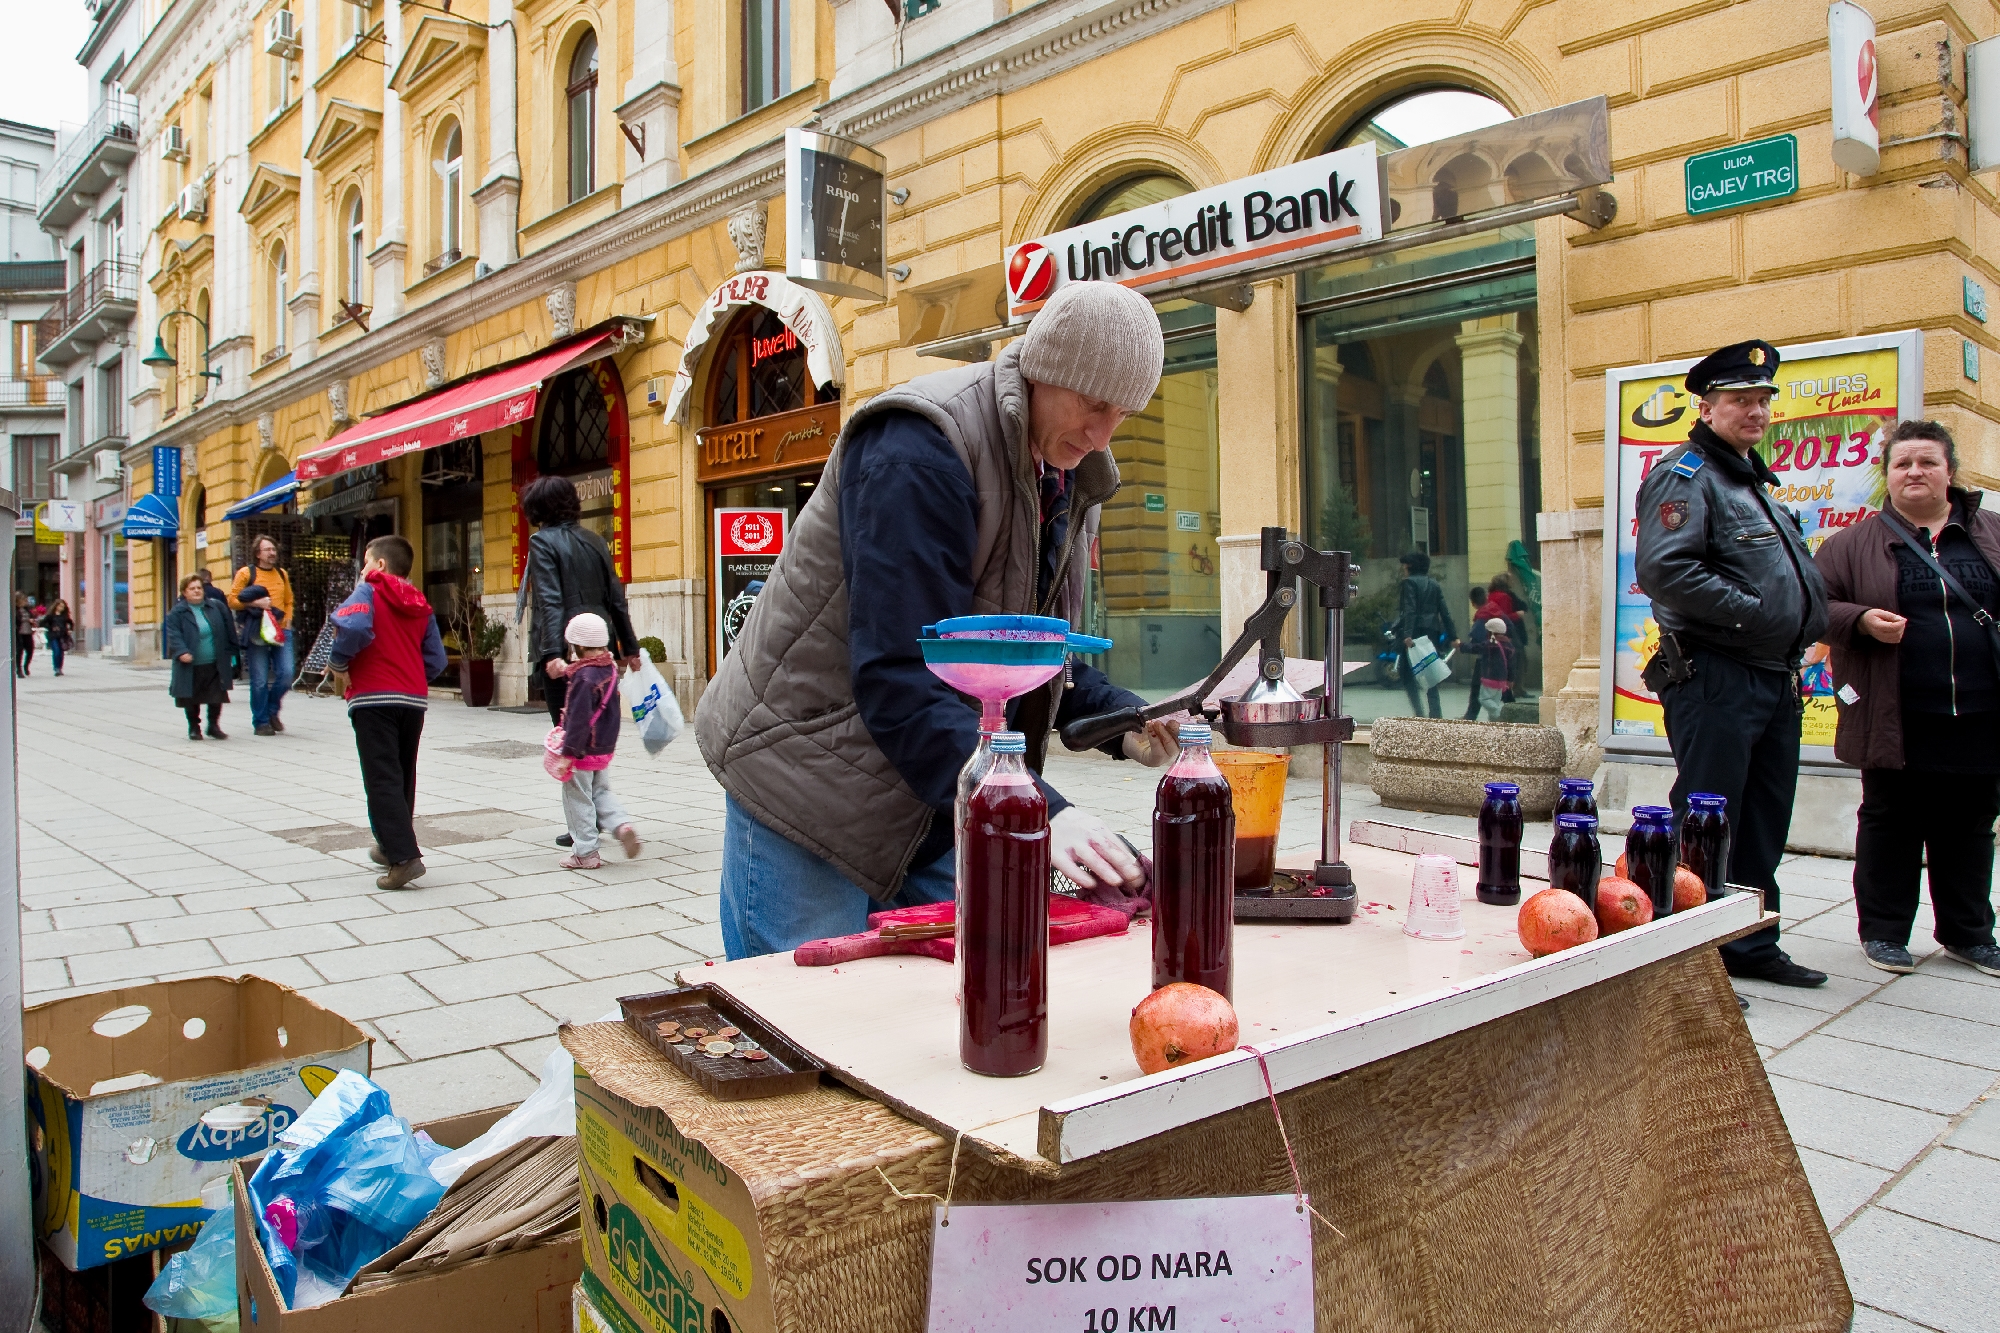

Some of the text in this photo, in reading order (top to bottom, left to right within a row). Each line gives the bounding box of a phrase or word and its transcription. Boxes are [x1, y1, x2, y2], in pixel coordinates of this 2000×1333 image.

[838, 172, 848, 184] 12
[1723, 155, 1755, 170] ULICA
[825, 184, 860, 204] RADO
[1691, 166, 1791, 201] GAJEV TRG
[870, 219, 875, 230] 3
[1067, 170, 1360, 281] UniCredit Bank
[840, 247, 847, 259] 6
[1787, 373, 1868, 401] TOURS
[1815, 387, 1881, 413] Tuzla
[705, 427, 765, 466] urar
[1768, 431, 1881, 473] 2013.
[511, 491, 520, 588] BUREK
[613, 469, 623, 578] BUREK
[743, 532, 760, 540] 2011
[744, 523, 760, 531] 1911
[728, 563, 753, 572] PLANET
[187, 1110, 290, 1151] derby
[624, 1117, 685, 1181] VACUUM PACK
[103, 1220, 207, 1260] NANAS
[611, 1217, 701, 1333] slobana
[1025, 1250, 1233, 1285] SOK OD NARA
[611, 1267, 653, 1323] PREMIUM
[1083, 1305, 1177, 1333] 10 KM
